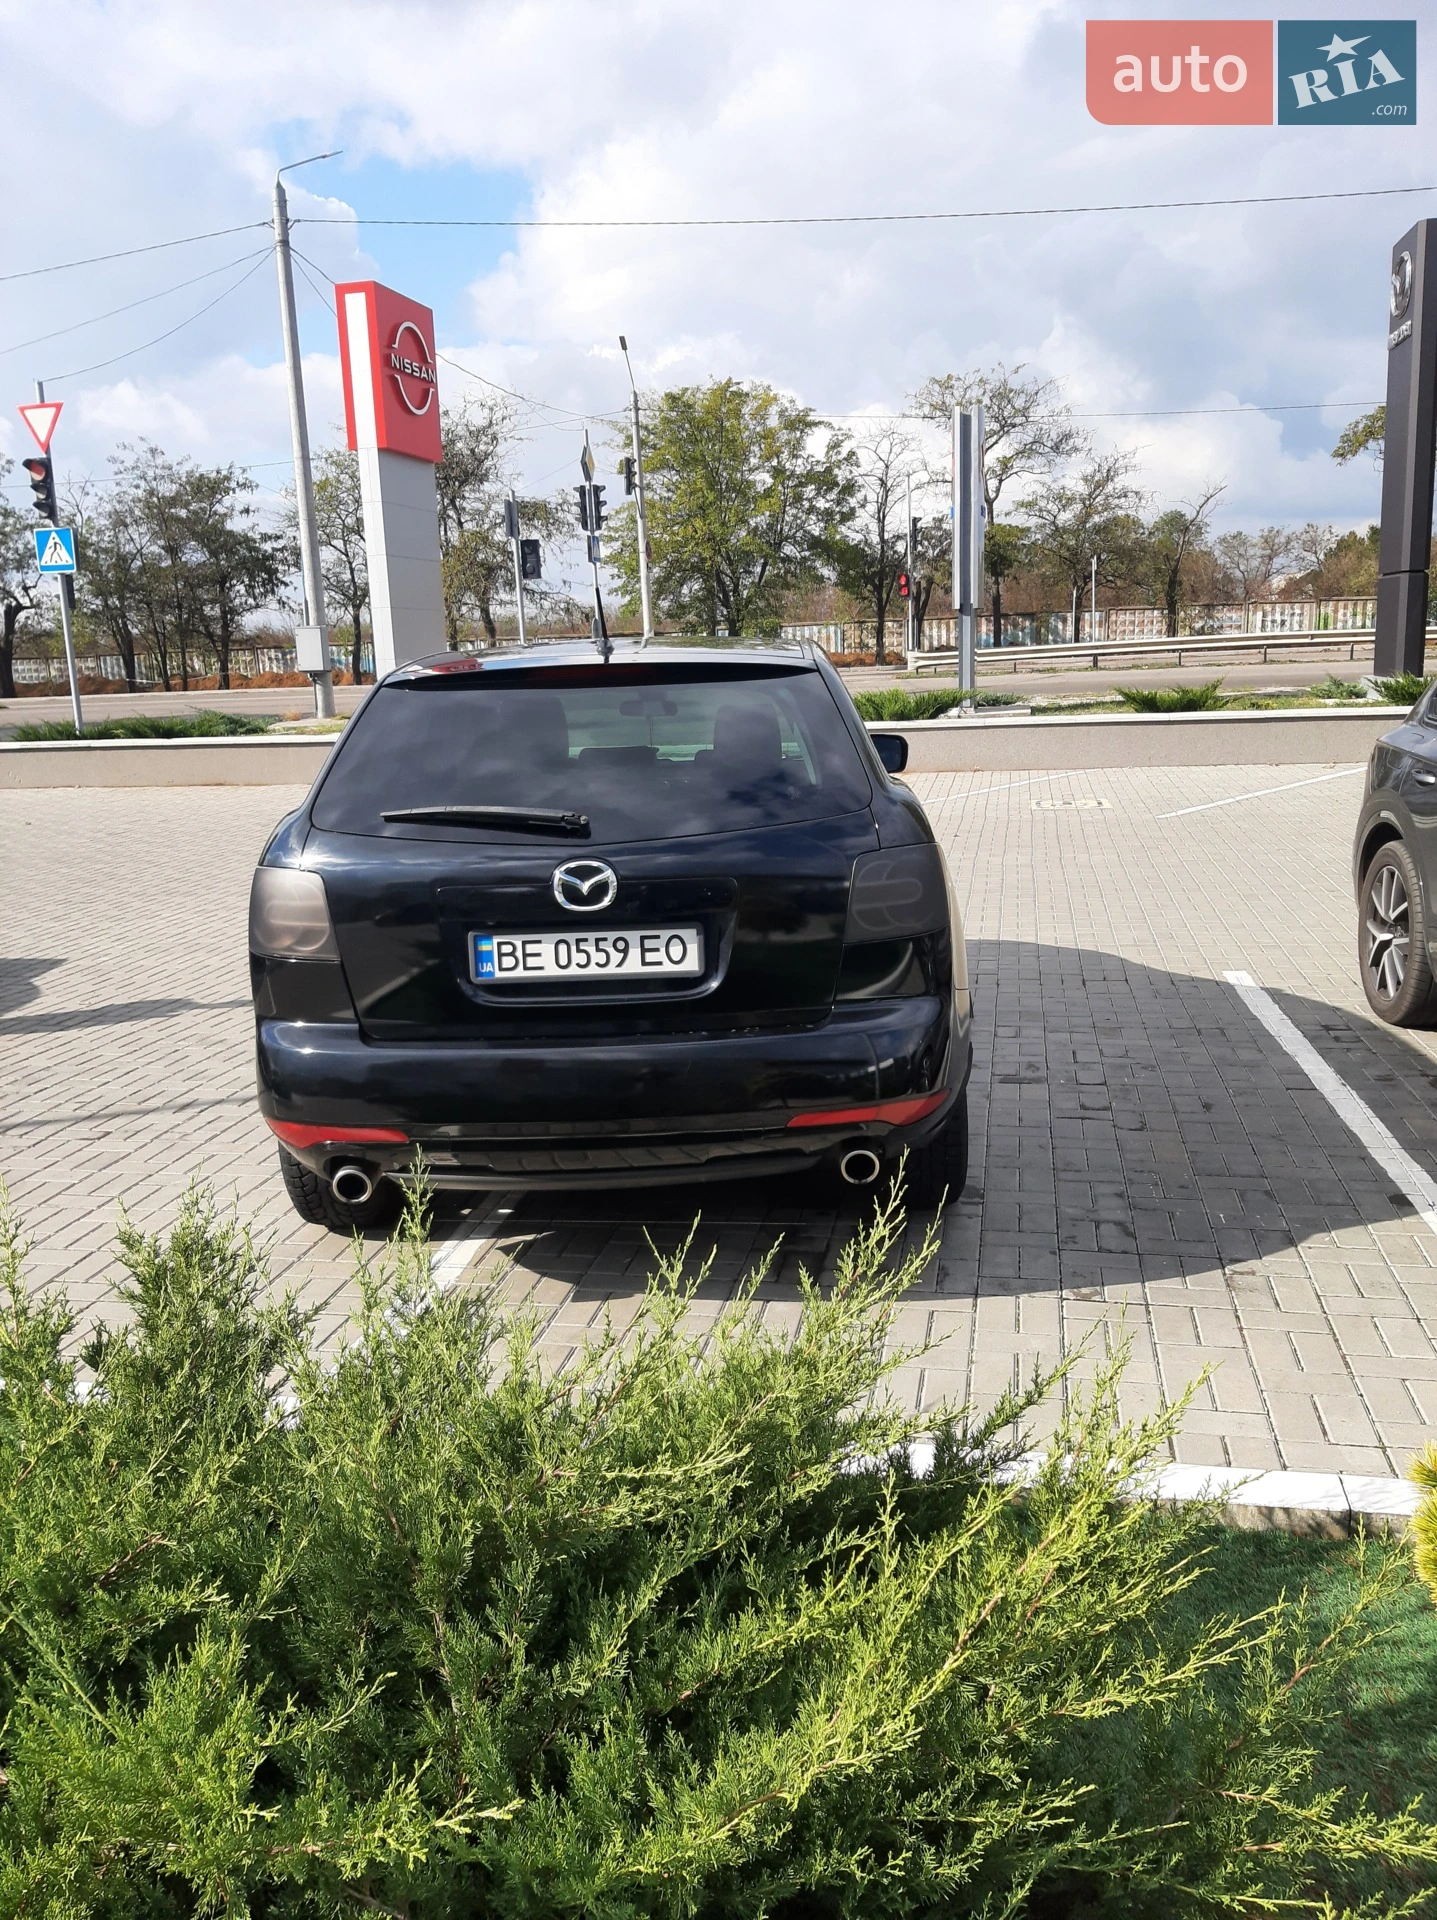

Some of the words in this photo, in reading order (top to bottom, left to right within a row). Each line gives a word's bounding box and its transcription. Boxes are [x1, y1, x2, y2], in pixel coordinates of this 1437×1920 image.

[391, 353, 436, 383] NISSAN
[479, 962, 493, 973] UA
[497, 939, 545, 972] BE
[554, 936, 630, 970] 0559
[639, 934, 688, 967] EO
